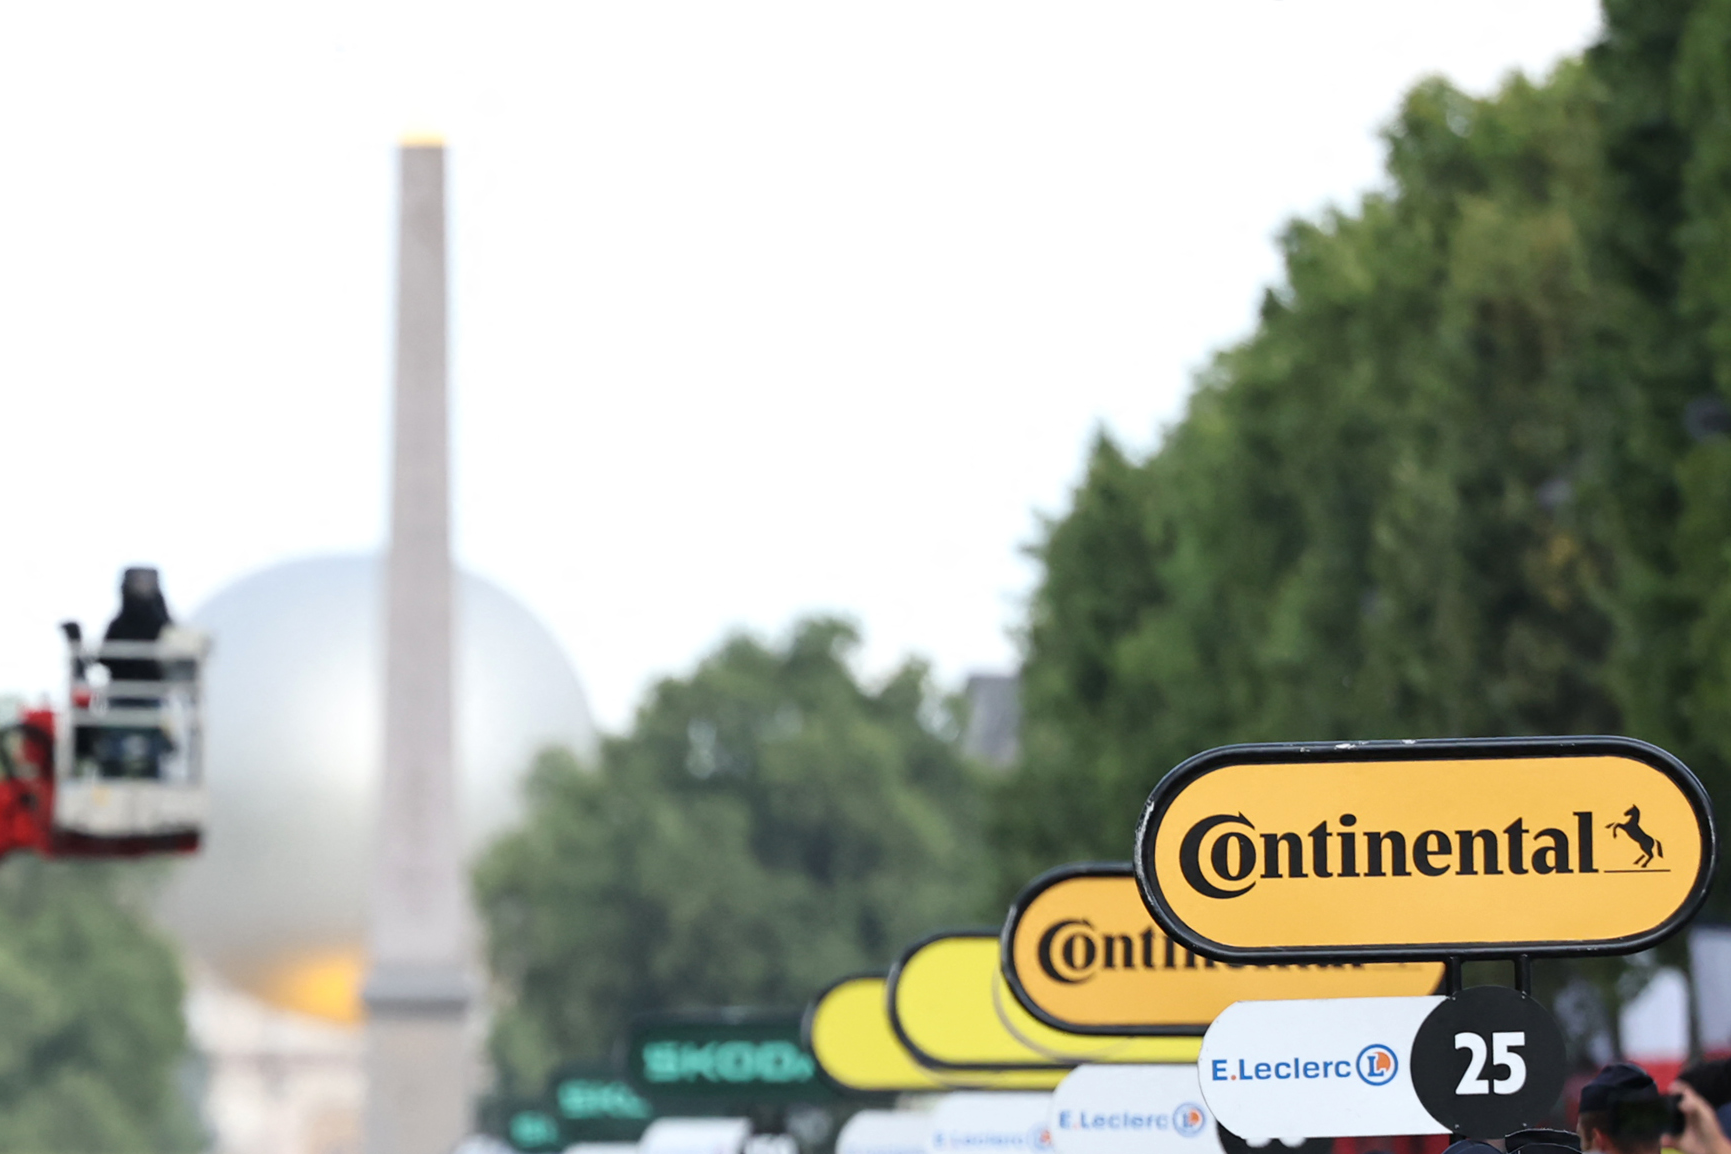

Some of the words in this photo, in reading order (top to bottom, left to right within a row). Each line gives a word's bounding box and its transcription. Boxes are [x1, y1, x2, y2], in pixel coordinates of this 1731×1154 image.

[1180, 812, 1598, 899] Continental
[1212, 1057, 1352, 1081] E.Leclerc
[1455, 1032, 1526, 1094] 25
[1058, 1110, 1169, 1130] E.Leclerc
